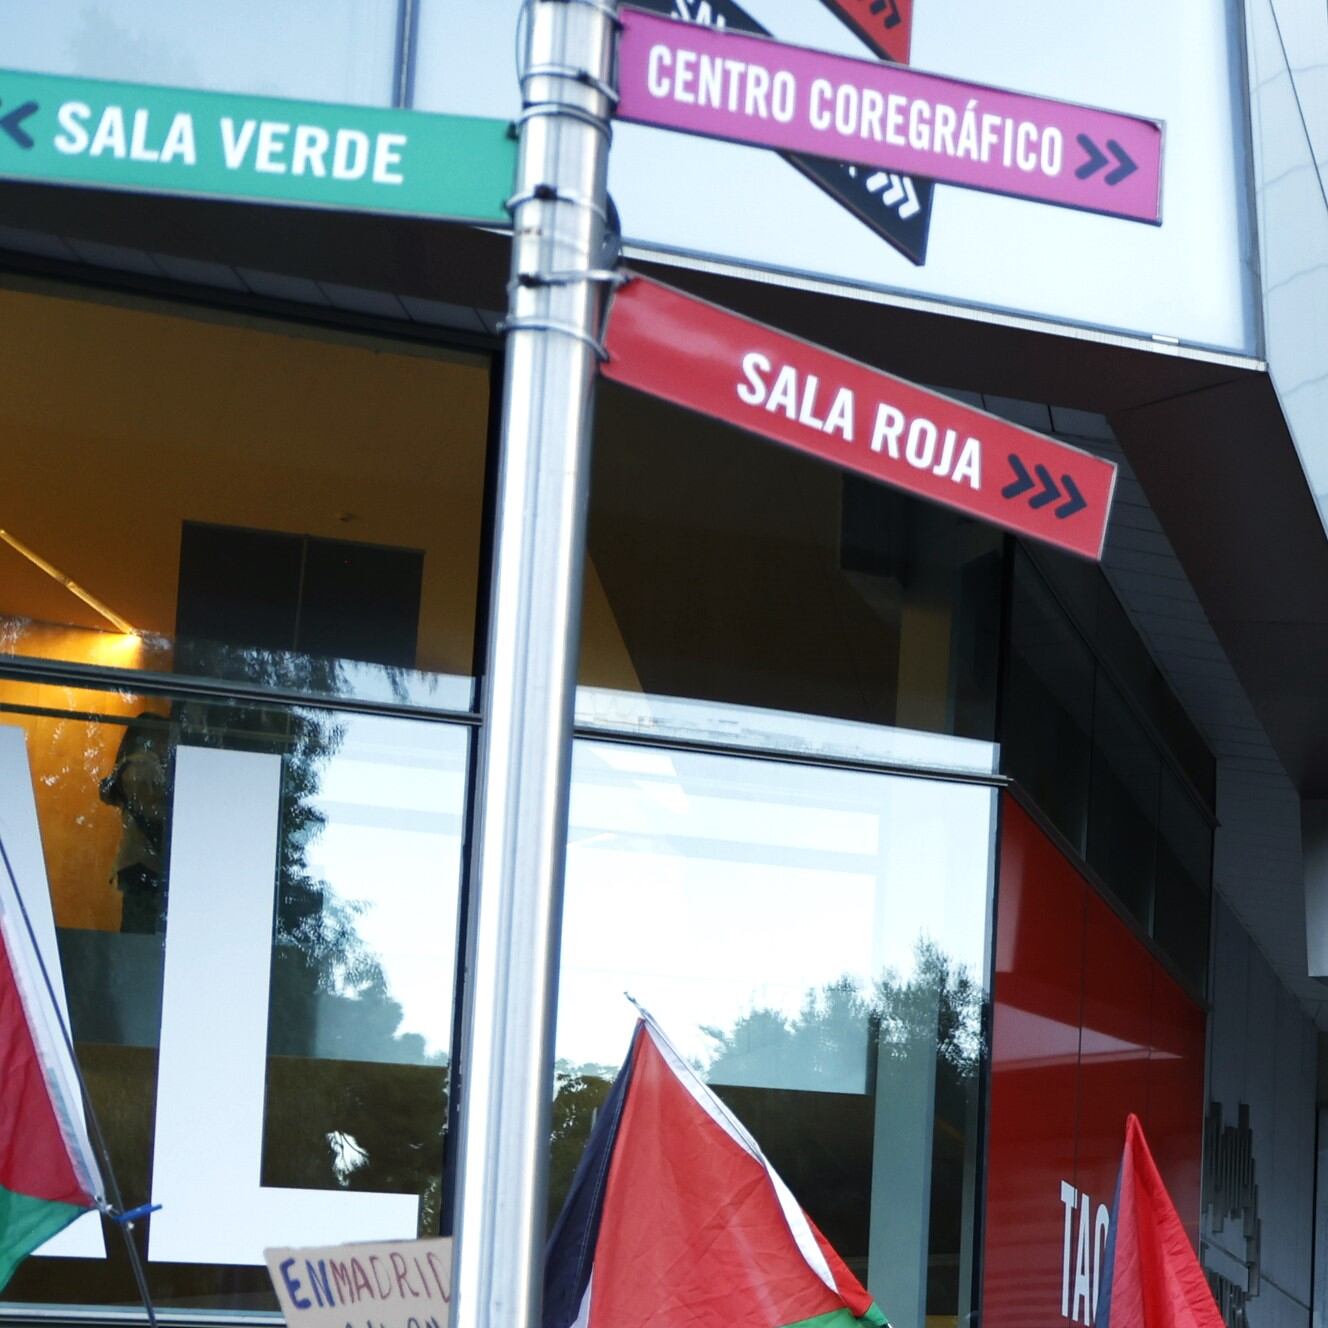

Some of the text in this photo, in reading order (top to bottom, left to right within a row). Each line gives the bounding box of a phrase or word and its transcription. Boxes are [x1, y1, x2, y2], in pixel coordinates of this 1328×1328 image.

[52, 101, 407, 185] SALA VERDE
[646, 44, 1064, 178] CENTRO COREGRÁFICO
[734, 350, 983, 491] SALA ROJA
[279, 1257, 335, 1310] EN
